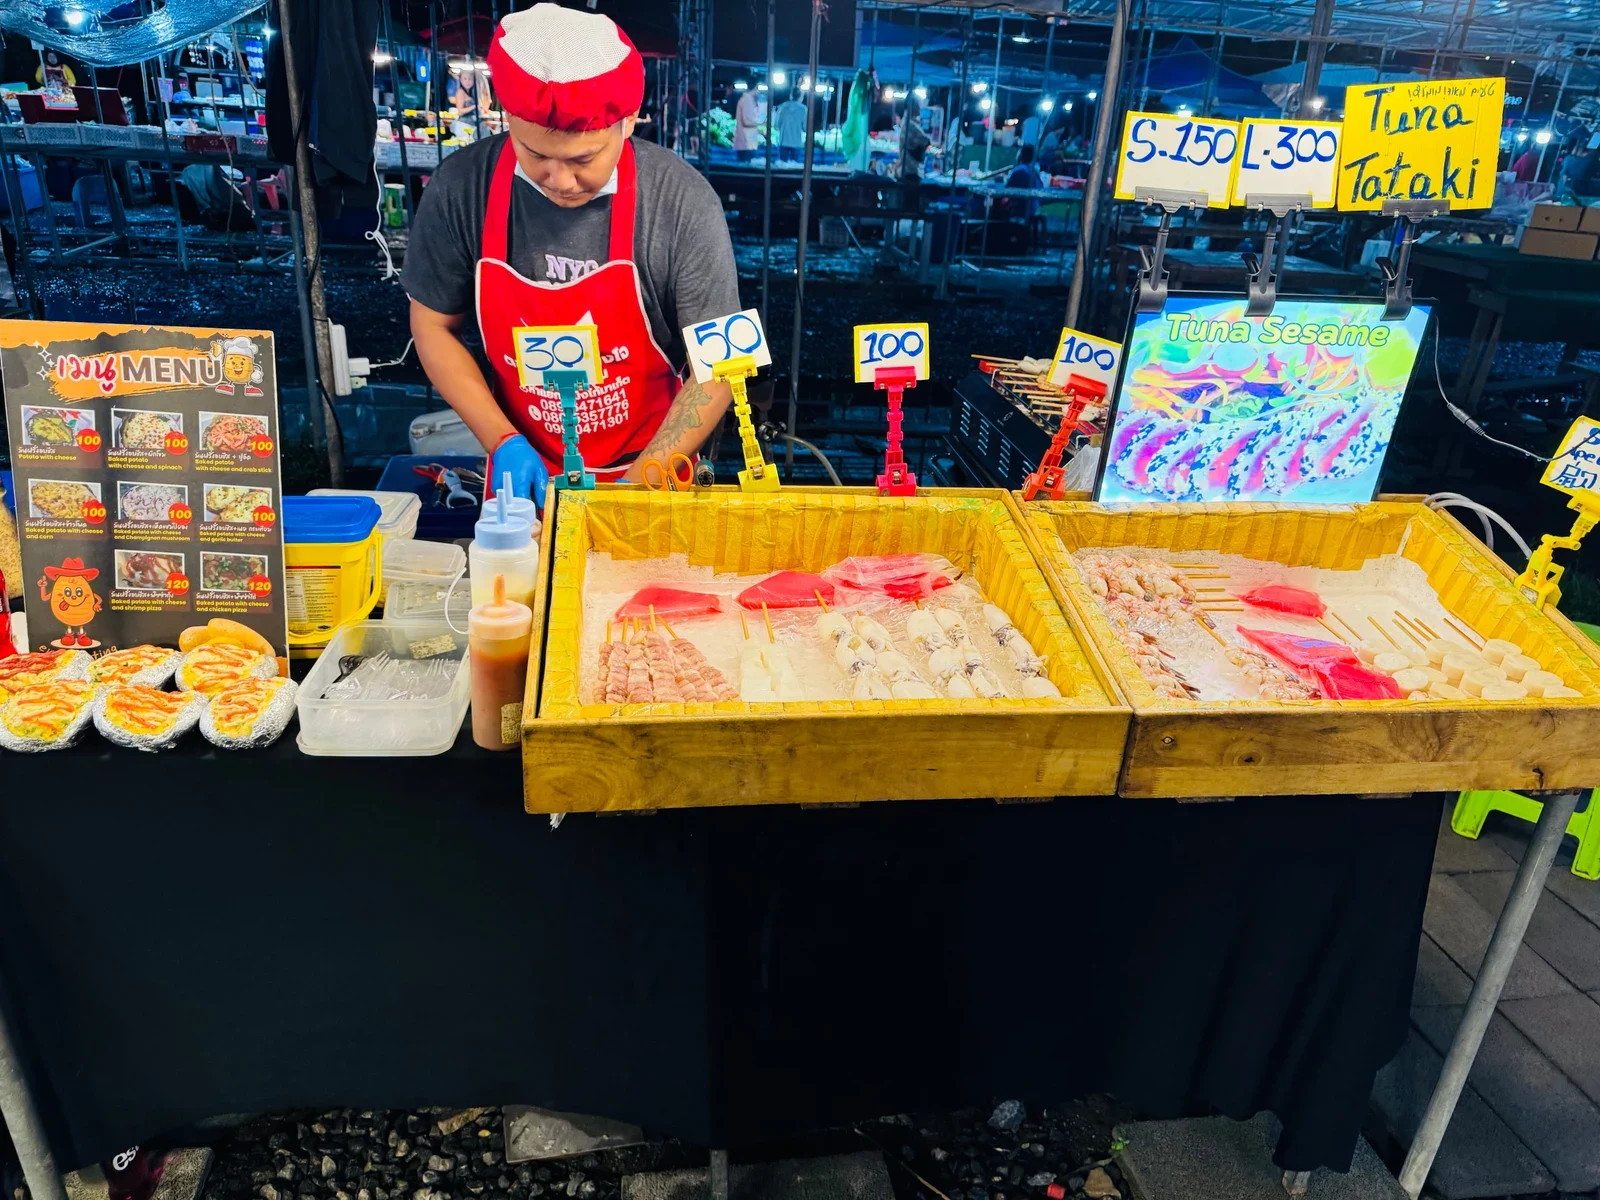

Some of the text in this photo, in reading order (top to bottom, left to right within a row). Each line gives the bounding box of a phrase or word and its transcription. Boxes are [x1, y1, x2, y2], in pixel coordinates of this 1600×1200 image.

[1364, 86, 1474, 135] Tuna
[1344, 146, 1480, 204] Tataki
[694, 314, 762, 368] 50
[1166, 313, 1390, 346] Tuna Sesame
[524, 336, 584, 370] 30
[860, 331, 924, 364] 100
[1059, 336, 1114, 370] 100
[57, 355, 116, 392] เมนู
[122, 356, 222, 384] MENU
[77, 436, 101, 445] 100
[165, 438, 188, 448] 100
[251, 442, 272, 450] 100
[82, 508, 106, 517] 100
[169, 510, 192, 519] 100
[254, 512, 275, 521] 100
[166, 580, 189, 589] 120
[249, 582, 271, 591] 120
